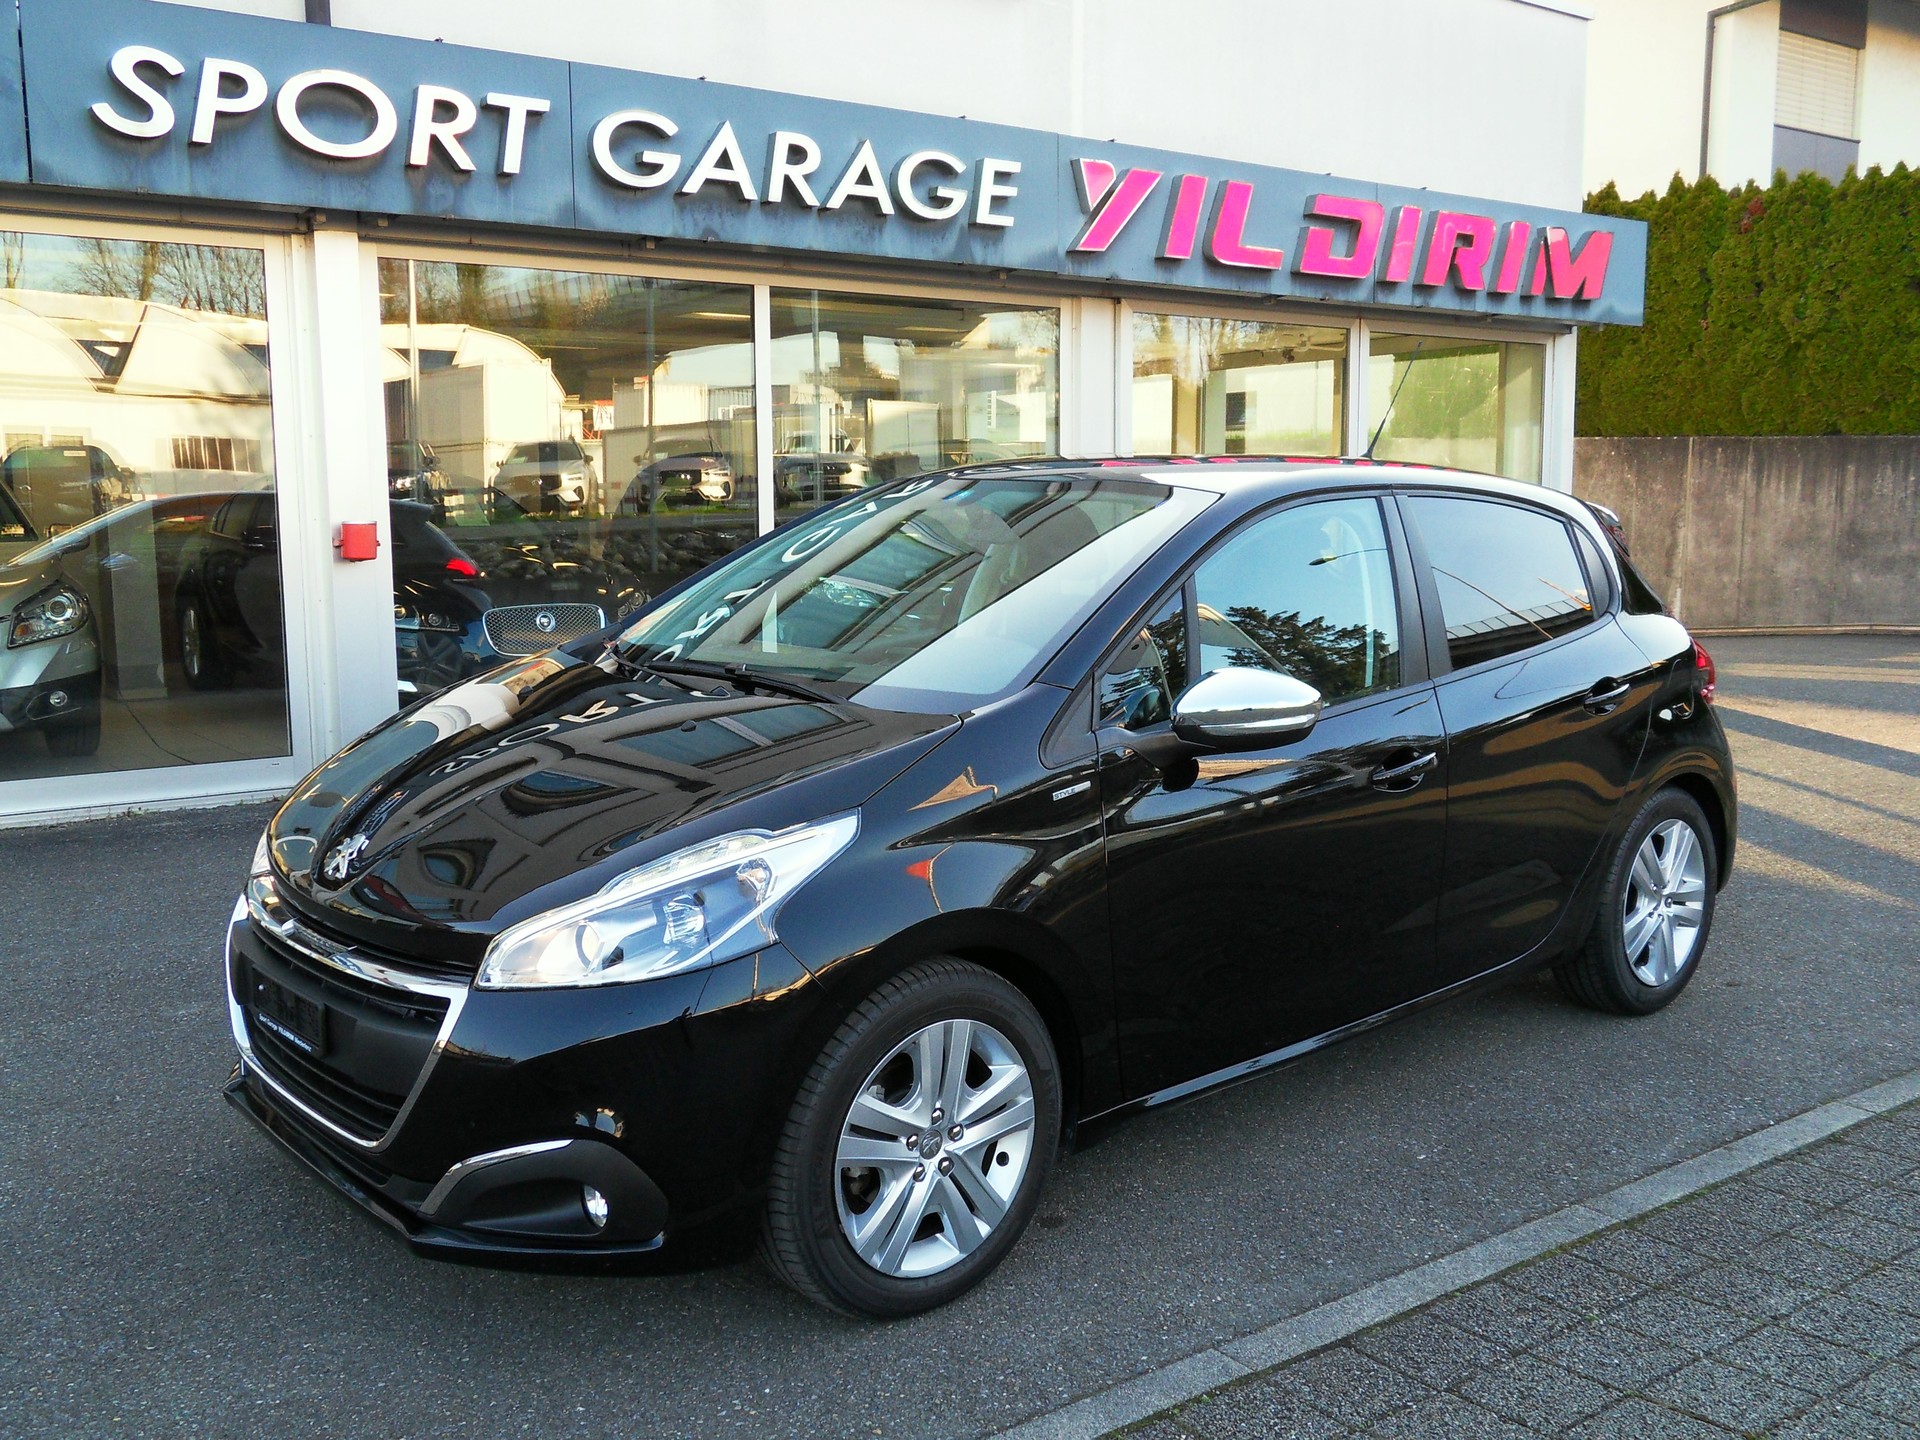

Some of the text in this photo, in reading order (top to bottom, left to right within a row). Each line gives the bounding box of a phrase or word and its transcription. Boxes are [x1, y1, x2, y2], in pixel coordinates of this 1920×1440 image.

[89, 44, 1613, 300] SPORT GARAGE YILDIRIM
[1054, 787, 1076, 800] STYLE
